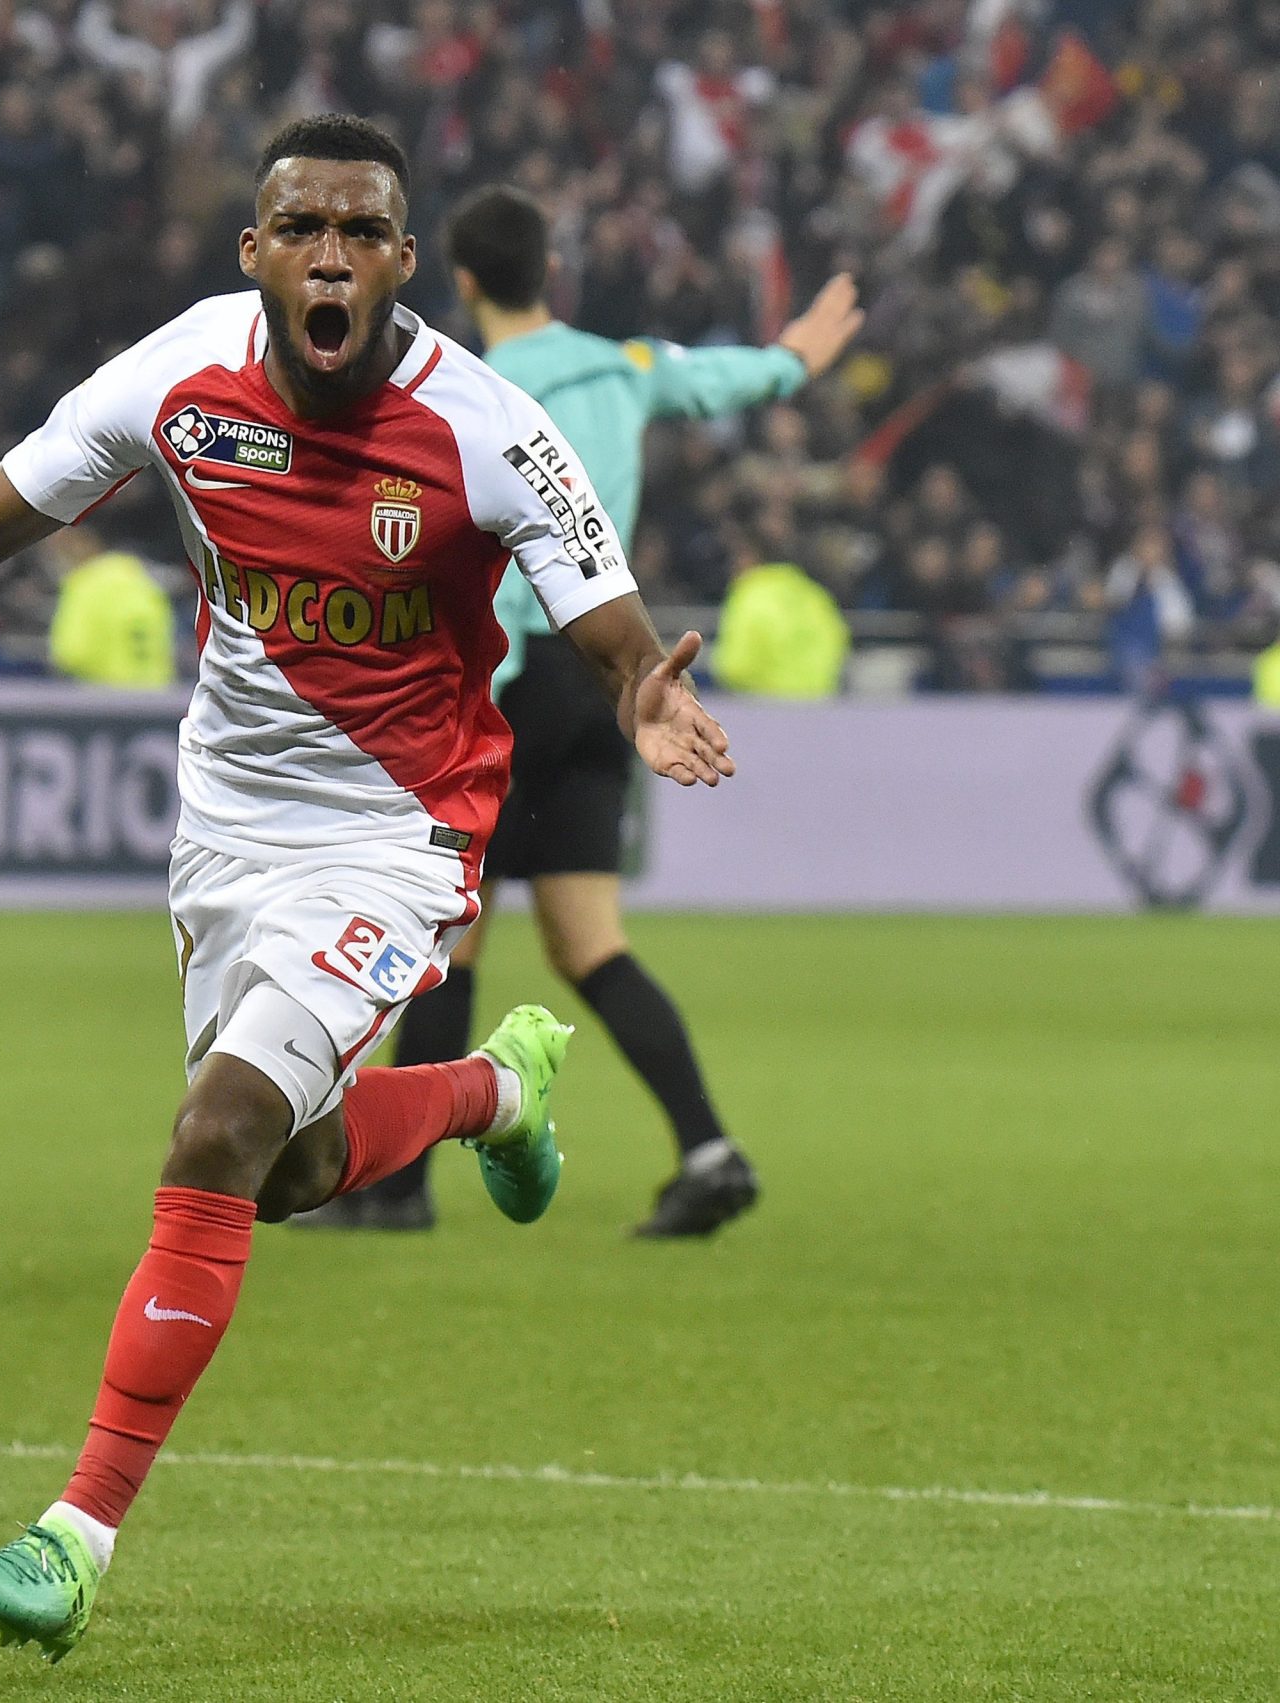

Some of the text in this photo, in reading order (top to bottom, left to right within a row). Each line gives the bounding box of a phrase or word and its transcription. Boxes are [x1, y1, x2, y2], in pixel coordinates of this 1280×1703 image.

[217, 421, 289, 449] PARIONS
[238, 446, 283, 464] sport
[517, 459, 593, 563] INTERIM
